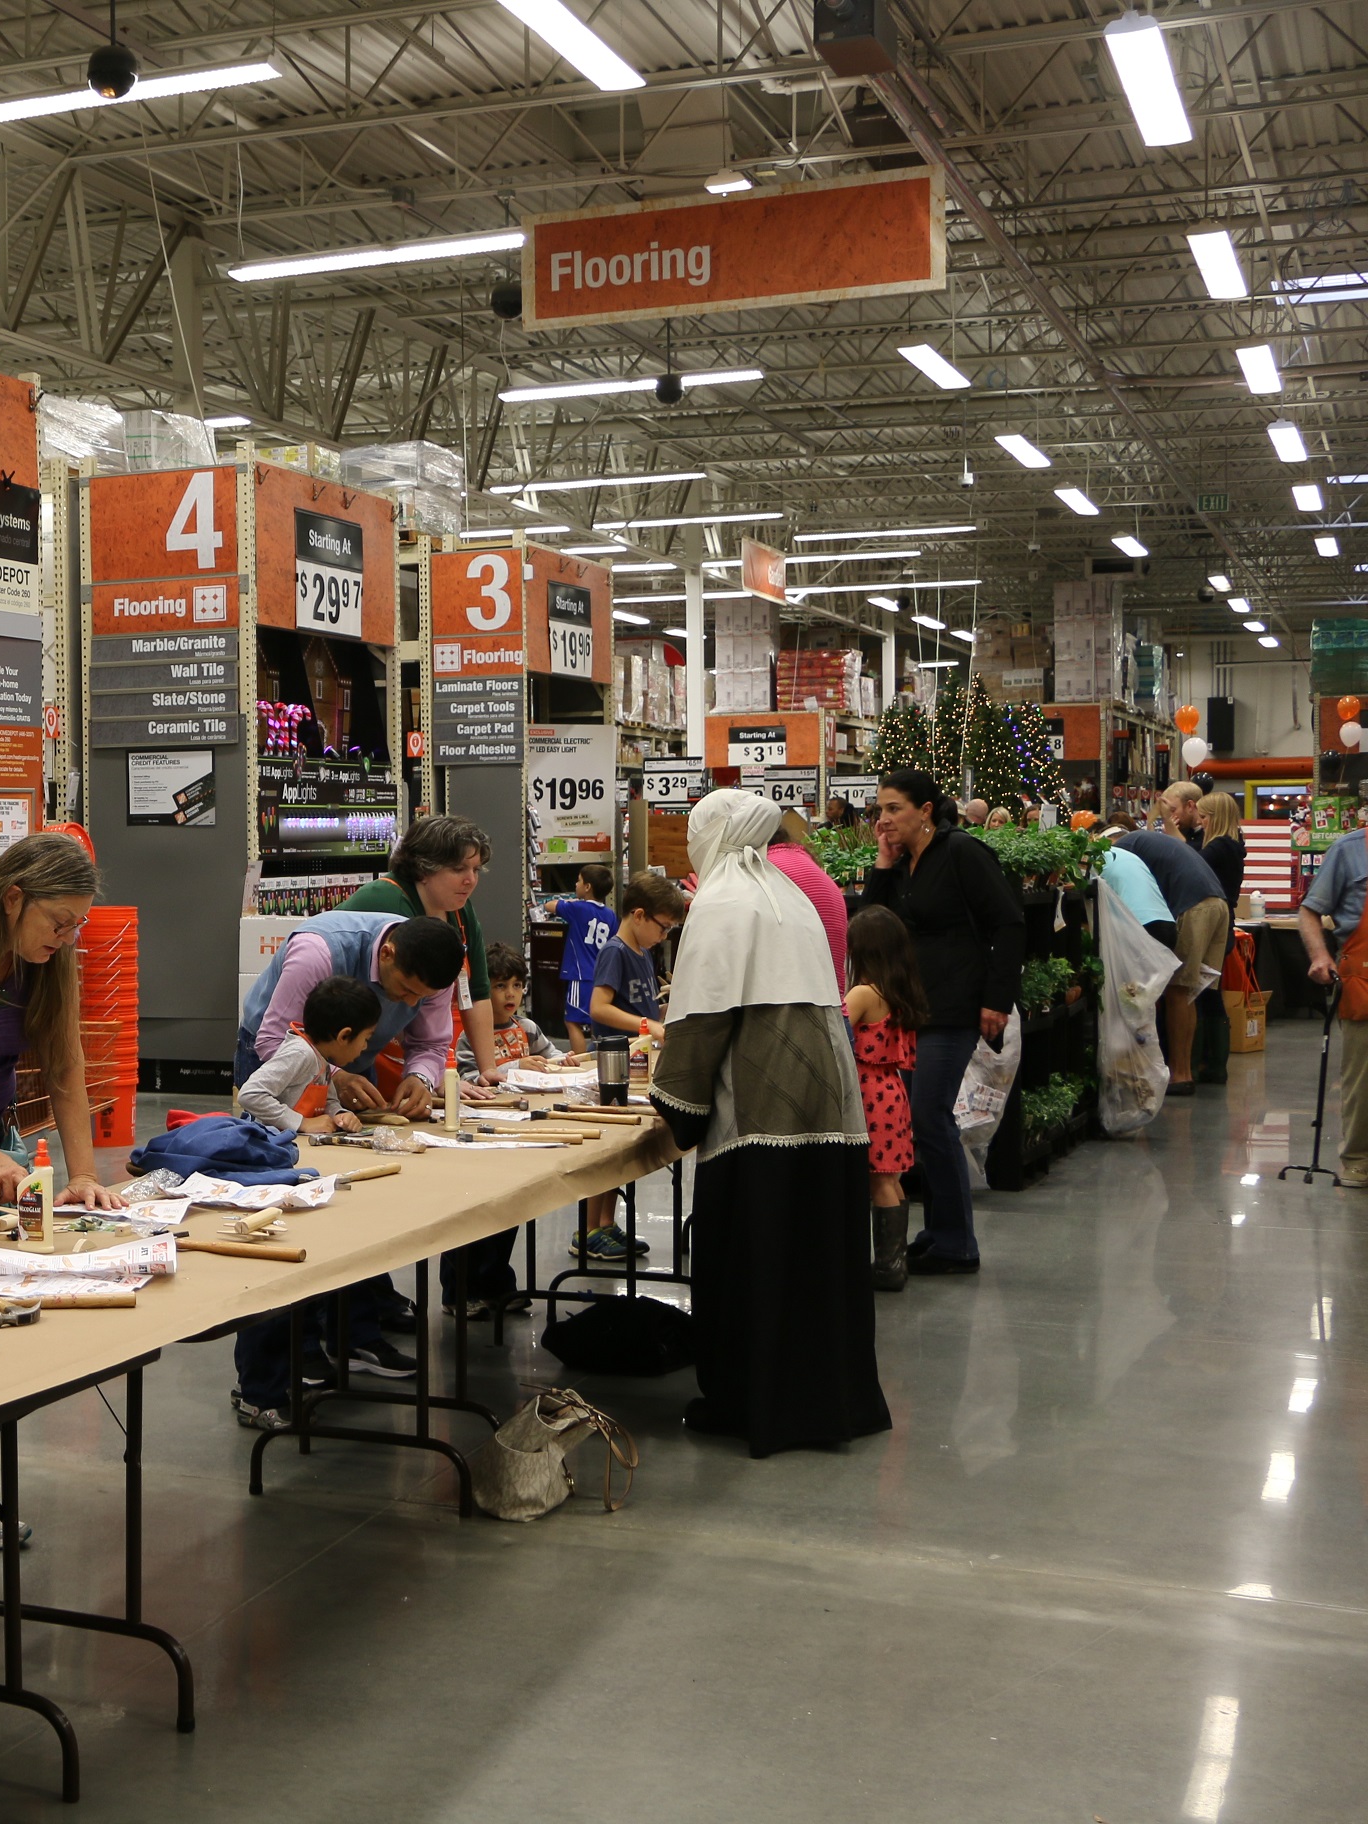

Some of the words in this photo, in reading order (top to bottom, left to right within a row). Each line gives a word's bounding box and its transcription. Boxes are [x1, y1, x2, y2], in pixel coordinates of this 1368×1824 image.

[550, 241, 711, 292] Flooring
[1202, 495, 1225, 510] EXIT
[165, 471, 223, 569] 4
[308, 528, 341, 556] Starting
[342, 537, 352, 555] At
[6, 586, 21, 597] Code
[465, 553, 511, 631] 3
[113, 596, 186, 617] Flooring
[555, 595, 577, 615] Starting
[577, 600, 584, 614] At
[132, 635, 226, 653] Marble/Granite
[463, 648, 524, 665] Flooring
[5, 666, 18, 676] Your
[170, 664, 198, 678] Wall
[201, 663, 224, 676] Tile
[435, 681, 483, 693] Laminate
[486, 680, 519, 691] Floors
[15, 692, 32, 705] Today
[152, 692, 226, 707] Slate/Stone
[450, 702, 485, 715] Carpet
[487, 701, 516, 712] Tools
[148, 720, 200, 734] Ceramic
[203, 719, 226, 733] Tile
[456, 723, 492, 736] Carpet
[494, 722, 514, 734] Pad
[528, 737, 562, 745] COMMERCIAL
[739, 731, 767, 741] Starting
[768, 731, 776, 739] At
[439, 745, 466, 756] Floor
[468, 743, 516, 755] Adhesive
[282, 782, 317, 804] AppLights
[584, 917, 610, 950] 18
